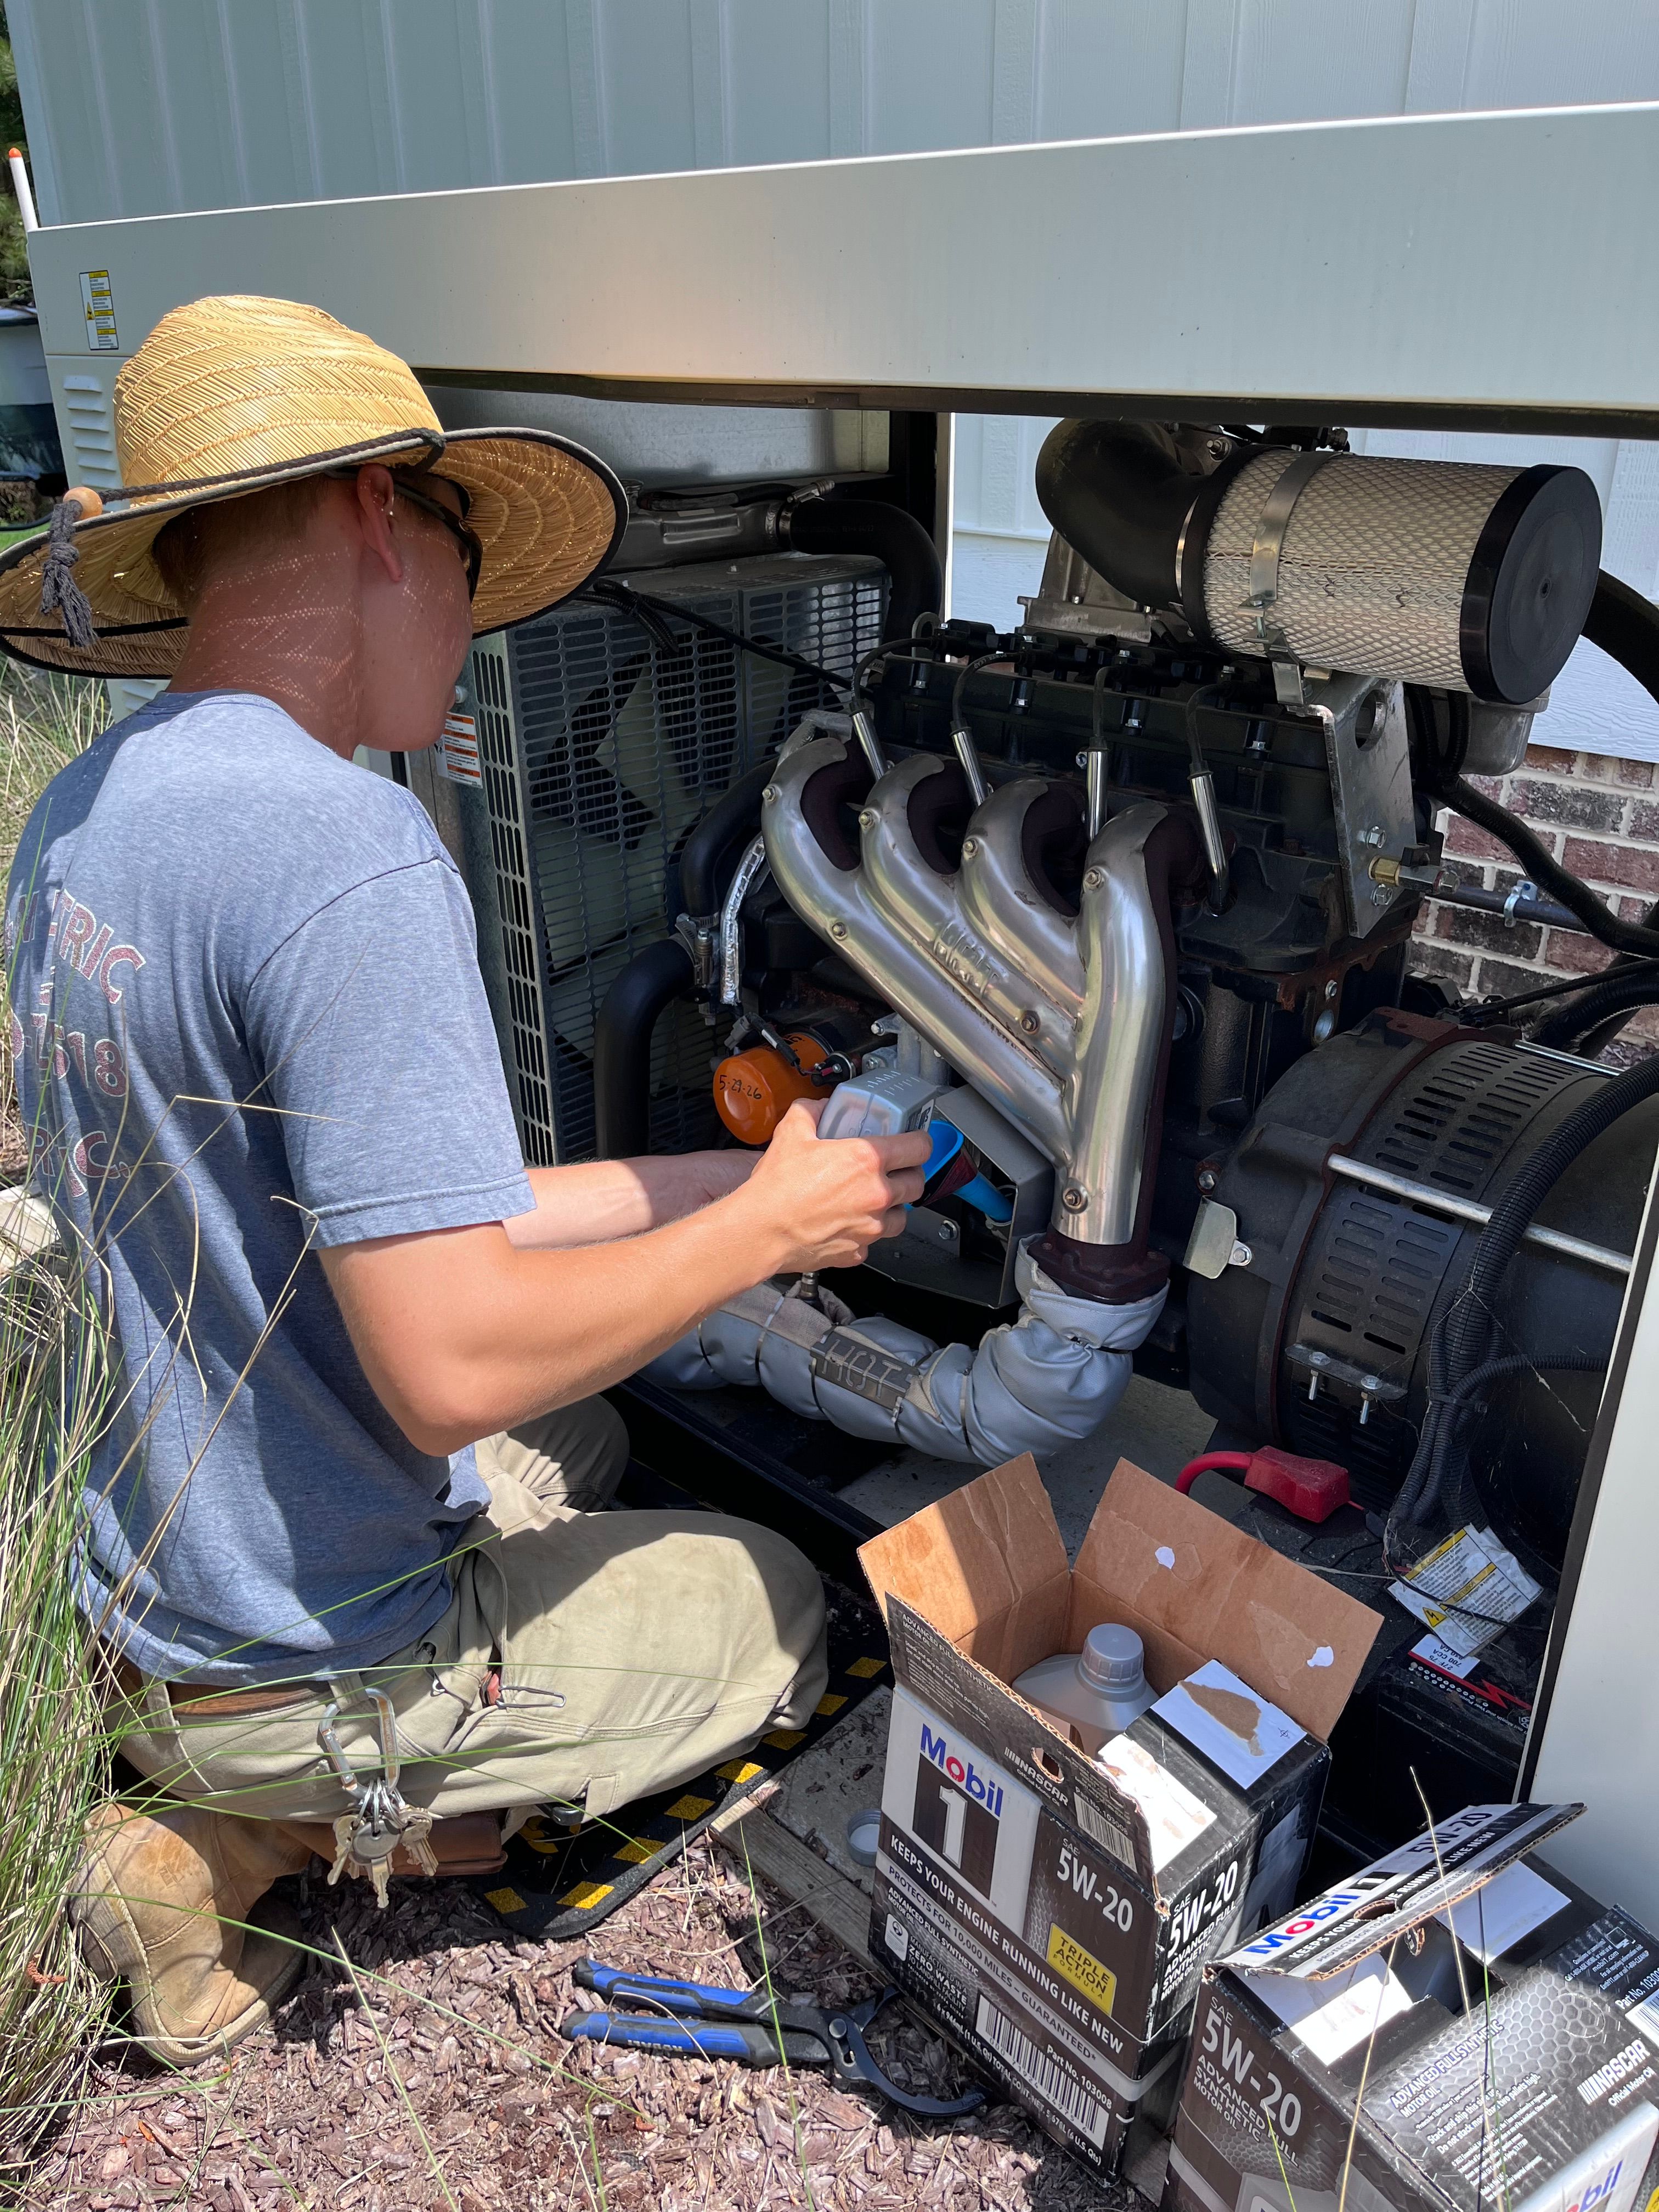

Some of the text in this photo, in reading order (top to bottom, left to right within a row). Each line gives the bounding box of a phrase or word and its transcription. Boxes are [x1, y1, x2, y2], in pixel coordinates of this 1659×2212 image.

[822, 1339, 902, 1400] HOT
[902, 1621, 923, 1640] MOTOR
[902, 1613, 938, 1646] ADVANCED
[955, 1660, 995, 1695] SYNTHETIC
[1433, 1649, 1462, 1667] 700 CCA
[920, 1723, 1005, 1819] Mobil
[1017, 1768, 1036, 1787] Official
[1019, 1758, 1069, 1807] NASCAR
[1075, 1786, 1090, 1803] Part
[1089, 1798, 1102, 1813] No.
[939, 1785, 968, 1870] 1
[1062, 1838, 1080, 1858] SAE
[1406, 1812, 1493, 1854] 5W-20
[887, 1894, 916, 1926] MOTOR OIL
[1057, 1847, 1133, 1932] 5W-20
[1167, 1860, 1239, 1959] 5W-20
[1173, 1893, 1192, 1917] SAE
[1243, 1877, 1387, 1954] Mobil 1
[1288, 1935, 1331, 1959] KEEPS
[1444, 1847, 1468, 1864] LIKE
[1466, 1831, 1497, 1850] NEW
[888, 1886, 924, 1925] ADVANCED
[923, 1921, 941, 1943] FULL
[940, 1938, 980, 1978] SYNTHETIC
[889, 1865, 932, 1913] PROTECTS
[933, 1908, 952, 1932] FOR
[952, 1927, 983, 1960] 10,000
[984, 1956, 1013, 1988] MILES
[890, 1834, 923, 1875] KEEPS
[924, 1865, 955, 1905] YOUR
[956, 1896, 1000, 1946] ENGINE
[1001, 1937, 1059, 2000] RUNNING
[1060, 1990, 1091, 2027] LIKE
[1091, 2017, 1124, 2055] NEW
[1164, 1900, 1237, 1978] ADVANCED FULL
[1316, 1937, 1356, 1962] PROTECTS
[908, 1944, 933, 1972] ZERO
[935, 1968, 968, 2006] WASTE
[908, 1953, 917, 1966] TO
[915, 1961, 942, 1991] LANDFILL
[941, 1985, 967, 2012] FACILITY
[910, 1936, 956, 1983] MANUFACTURED
[955, 1979, 962, 1990] IN
[962, 1987, 968, 1996] A
[1052, 1953, 1104, 2001] FORMULA
[1055, 1948, 1107, 1995] ACTION
[1060, 1936, 1110, 1985] TRIPLE
[1160, 1962, 1195, 2002] MOTOR OIL
[1162, 1934, 1212, 1991] SYNTHETIC
[1592, 1950, 1619, 1972] mobil1.com
[1615, 1967, 1659, 2010] Part No. 10300
[1210, 1996, 1234, 2027] SAE
[992, 2056, 1012, 2083] TOTAL
[1047, 2044, 1113, 2110] Part No. 103008
[1201, 2007, 1302, 2136] 5W-20
[1390, 2067, 1440, 2109] ADVANCED
[1438, 2050, 1461, 2075] FULL
[1593, 2039, 1651, 2099] NASCAR
[1607, 2084, 1631, 2107] Official
[1626, 2074, 1646, 2091] Motor
[1193, 2075, 1238, 2131] MOTOR OIL
[1195, 2065, 1262, 2143] SYNTHETIC
[1198, 2054, 1300, 2168] ADVANCED FULL
[1399, 2085, 1441, 2119] MOTOR OIL
[1427, 2103, 1479, 2145] Stack and ship this
[1436, 2144, 1449, 2154] Do
[1447, 2135, 1460, 2147] not
[1457, 2123, 1475, 2140] stack
[1508, 2082, 1528, 2101] pallets
